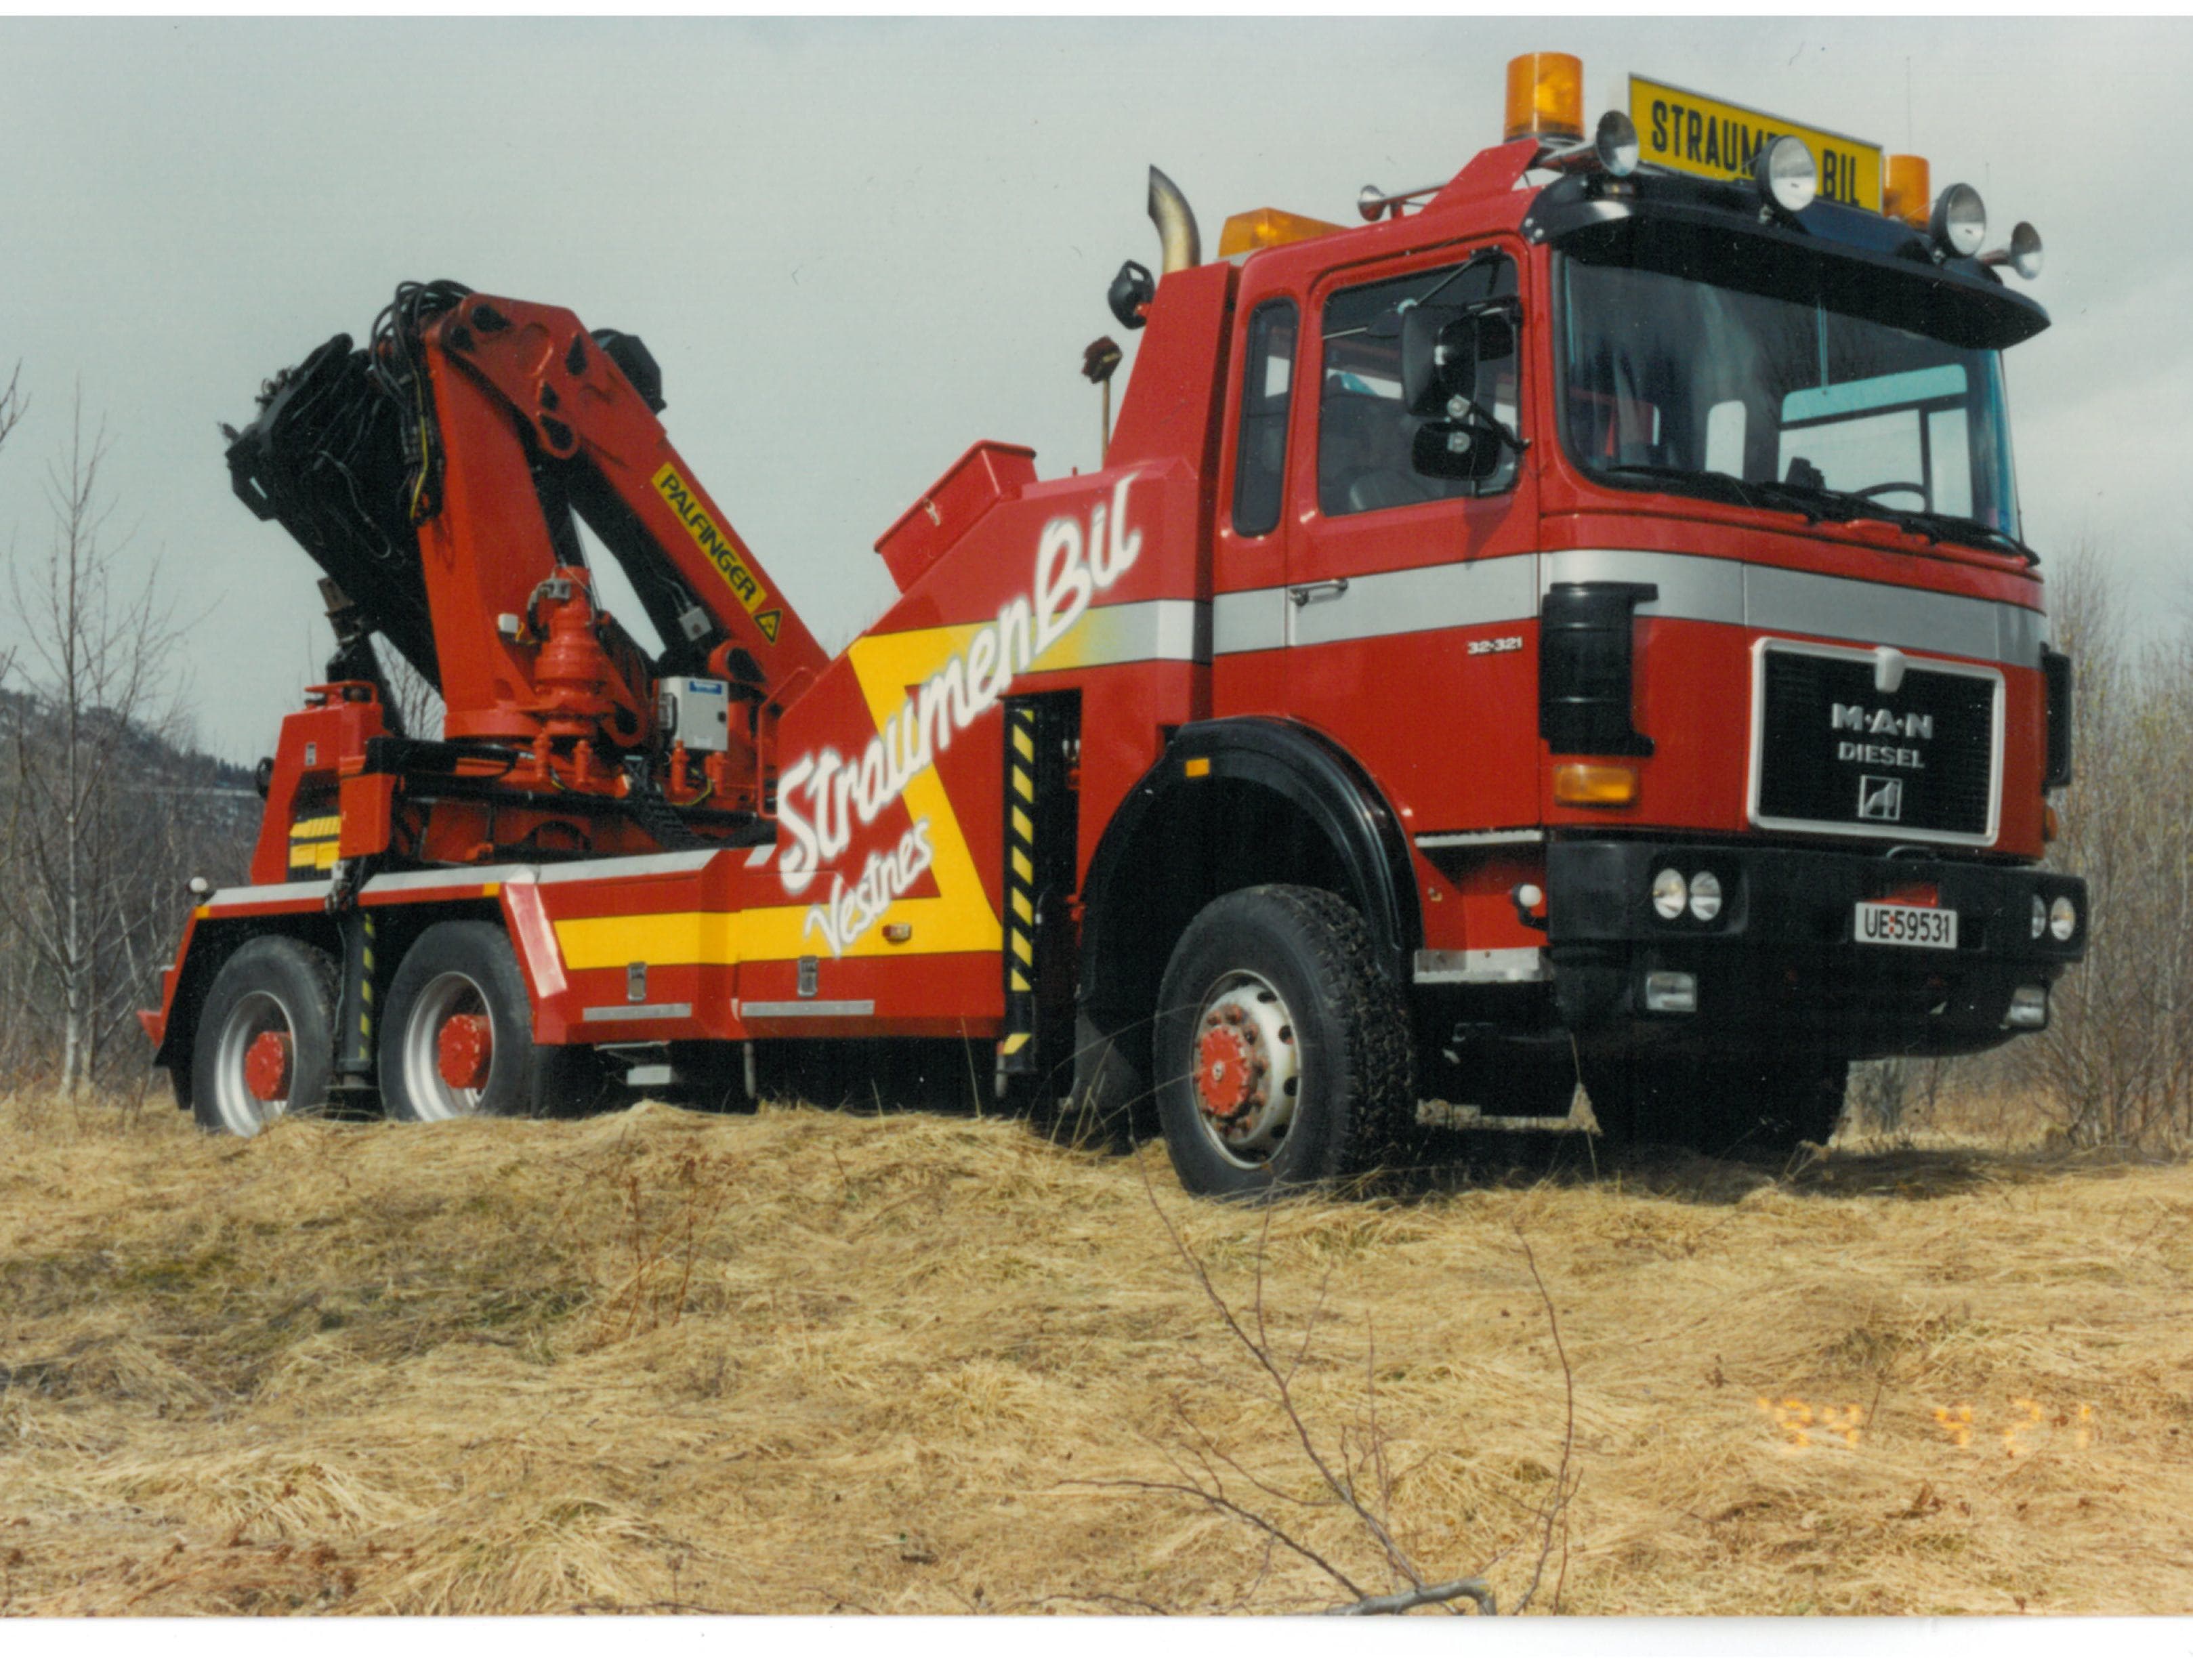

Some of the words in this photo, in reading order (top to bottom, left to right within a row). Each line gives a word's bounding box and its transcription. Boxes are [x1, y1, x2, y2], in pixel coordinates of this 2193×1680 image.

[1652, 100, 1776, 177] STRAUM
[1822, 148, 1860, 207] BIL
[661, 473, 757, 602] PALFINGER
[1839, 741, 1925, 768] DIESEL
[804, 816, 933, 959] Vestnes
